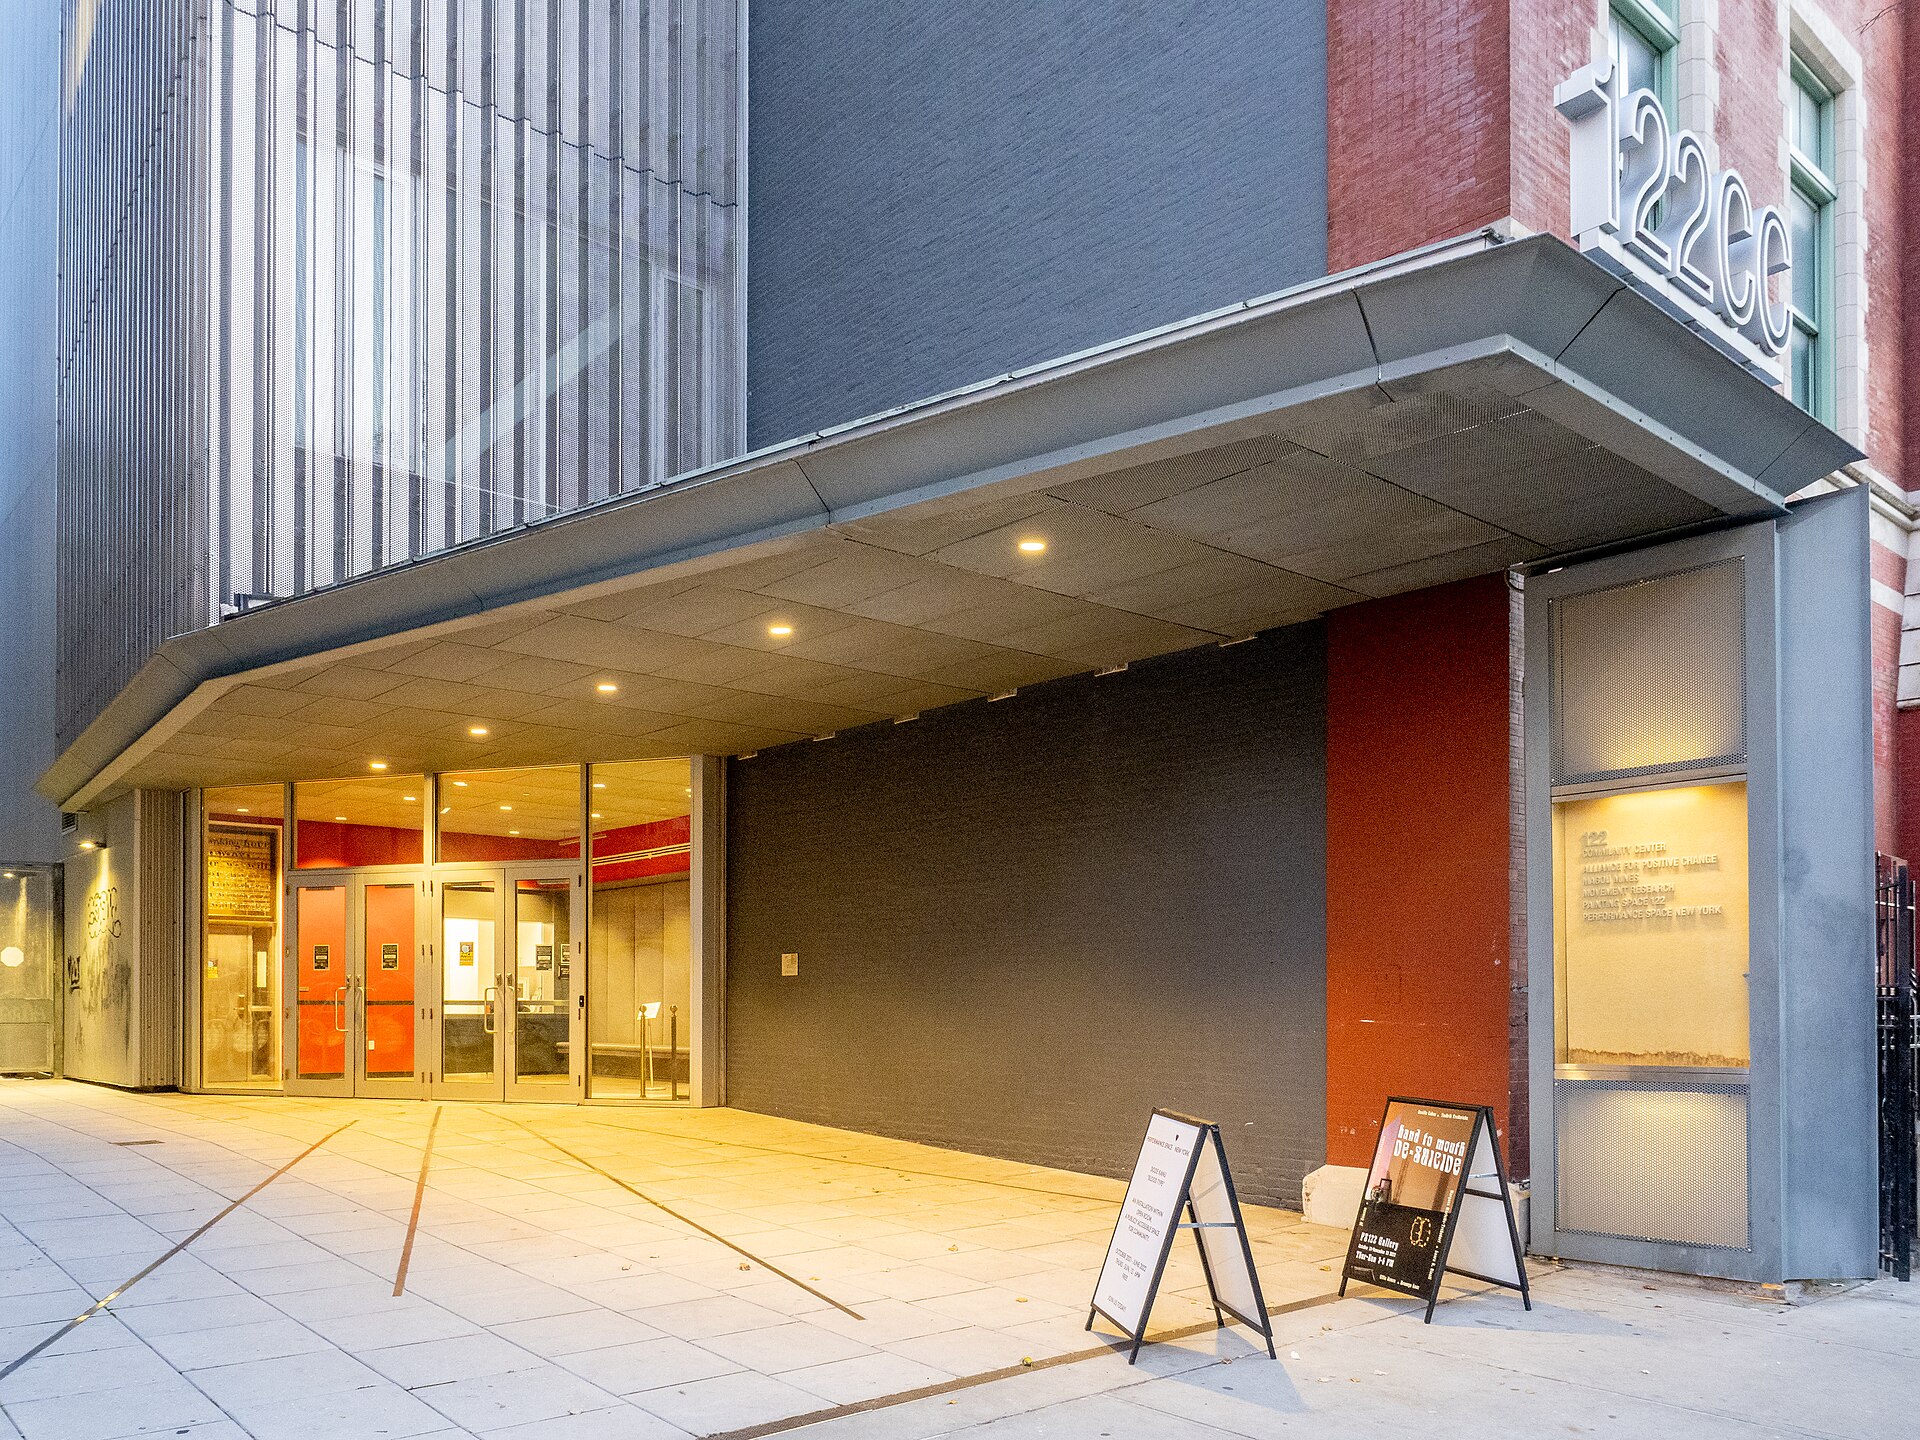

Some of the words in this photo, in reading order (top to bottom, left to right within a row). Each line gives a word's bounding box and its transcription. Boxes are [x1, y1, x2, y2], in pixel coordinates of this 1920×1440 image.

[1581, 831, 1608, 846] 122
[1583, 846, 1630, 858] COMMUNITY
[1634, 842, 1666, 853] CENTER
[1583, 862, 1621, 873] ALLIANCE
[1624, 861, 1639, 871] FOR
[1642, 858, 1679, 869] POSITIVE
[1681, 854, 1717, 865] CHANGE
[1614, 873, 1639, 884] MINES
[1583, 886, 1628, 898] MOVEMENT
[1630, 883, 1674, 894] RESEARCH
[1583, 899, 1619, 910] PAINTING
[1621, 897, 1648, 908] SPACE
[1650, 896, 1666, 906] 122
[1583, 910, 1643, 921] PERFORMANCE
[1645, 908, 1673, 918] SPACE
[1675, 906, 1696, 916] NEW
[1698, 904, 1722, 915] YORK
[1398, 1124, 1421, 1143] hand
[1436, 1138, 1465, 1157] mouth
